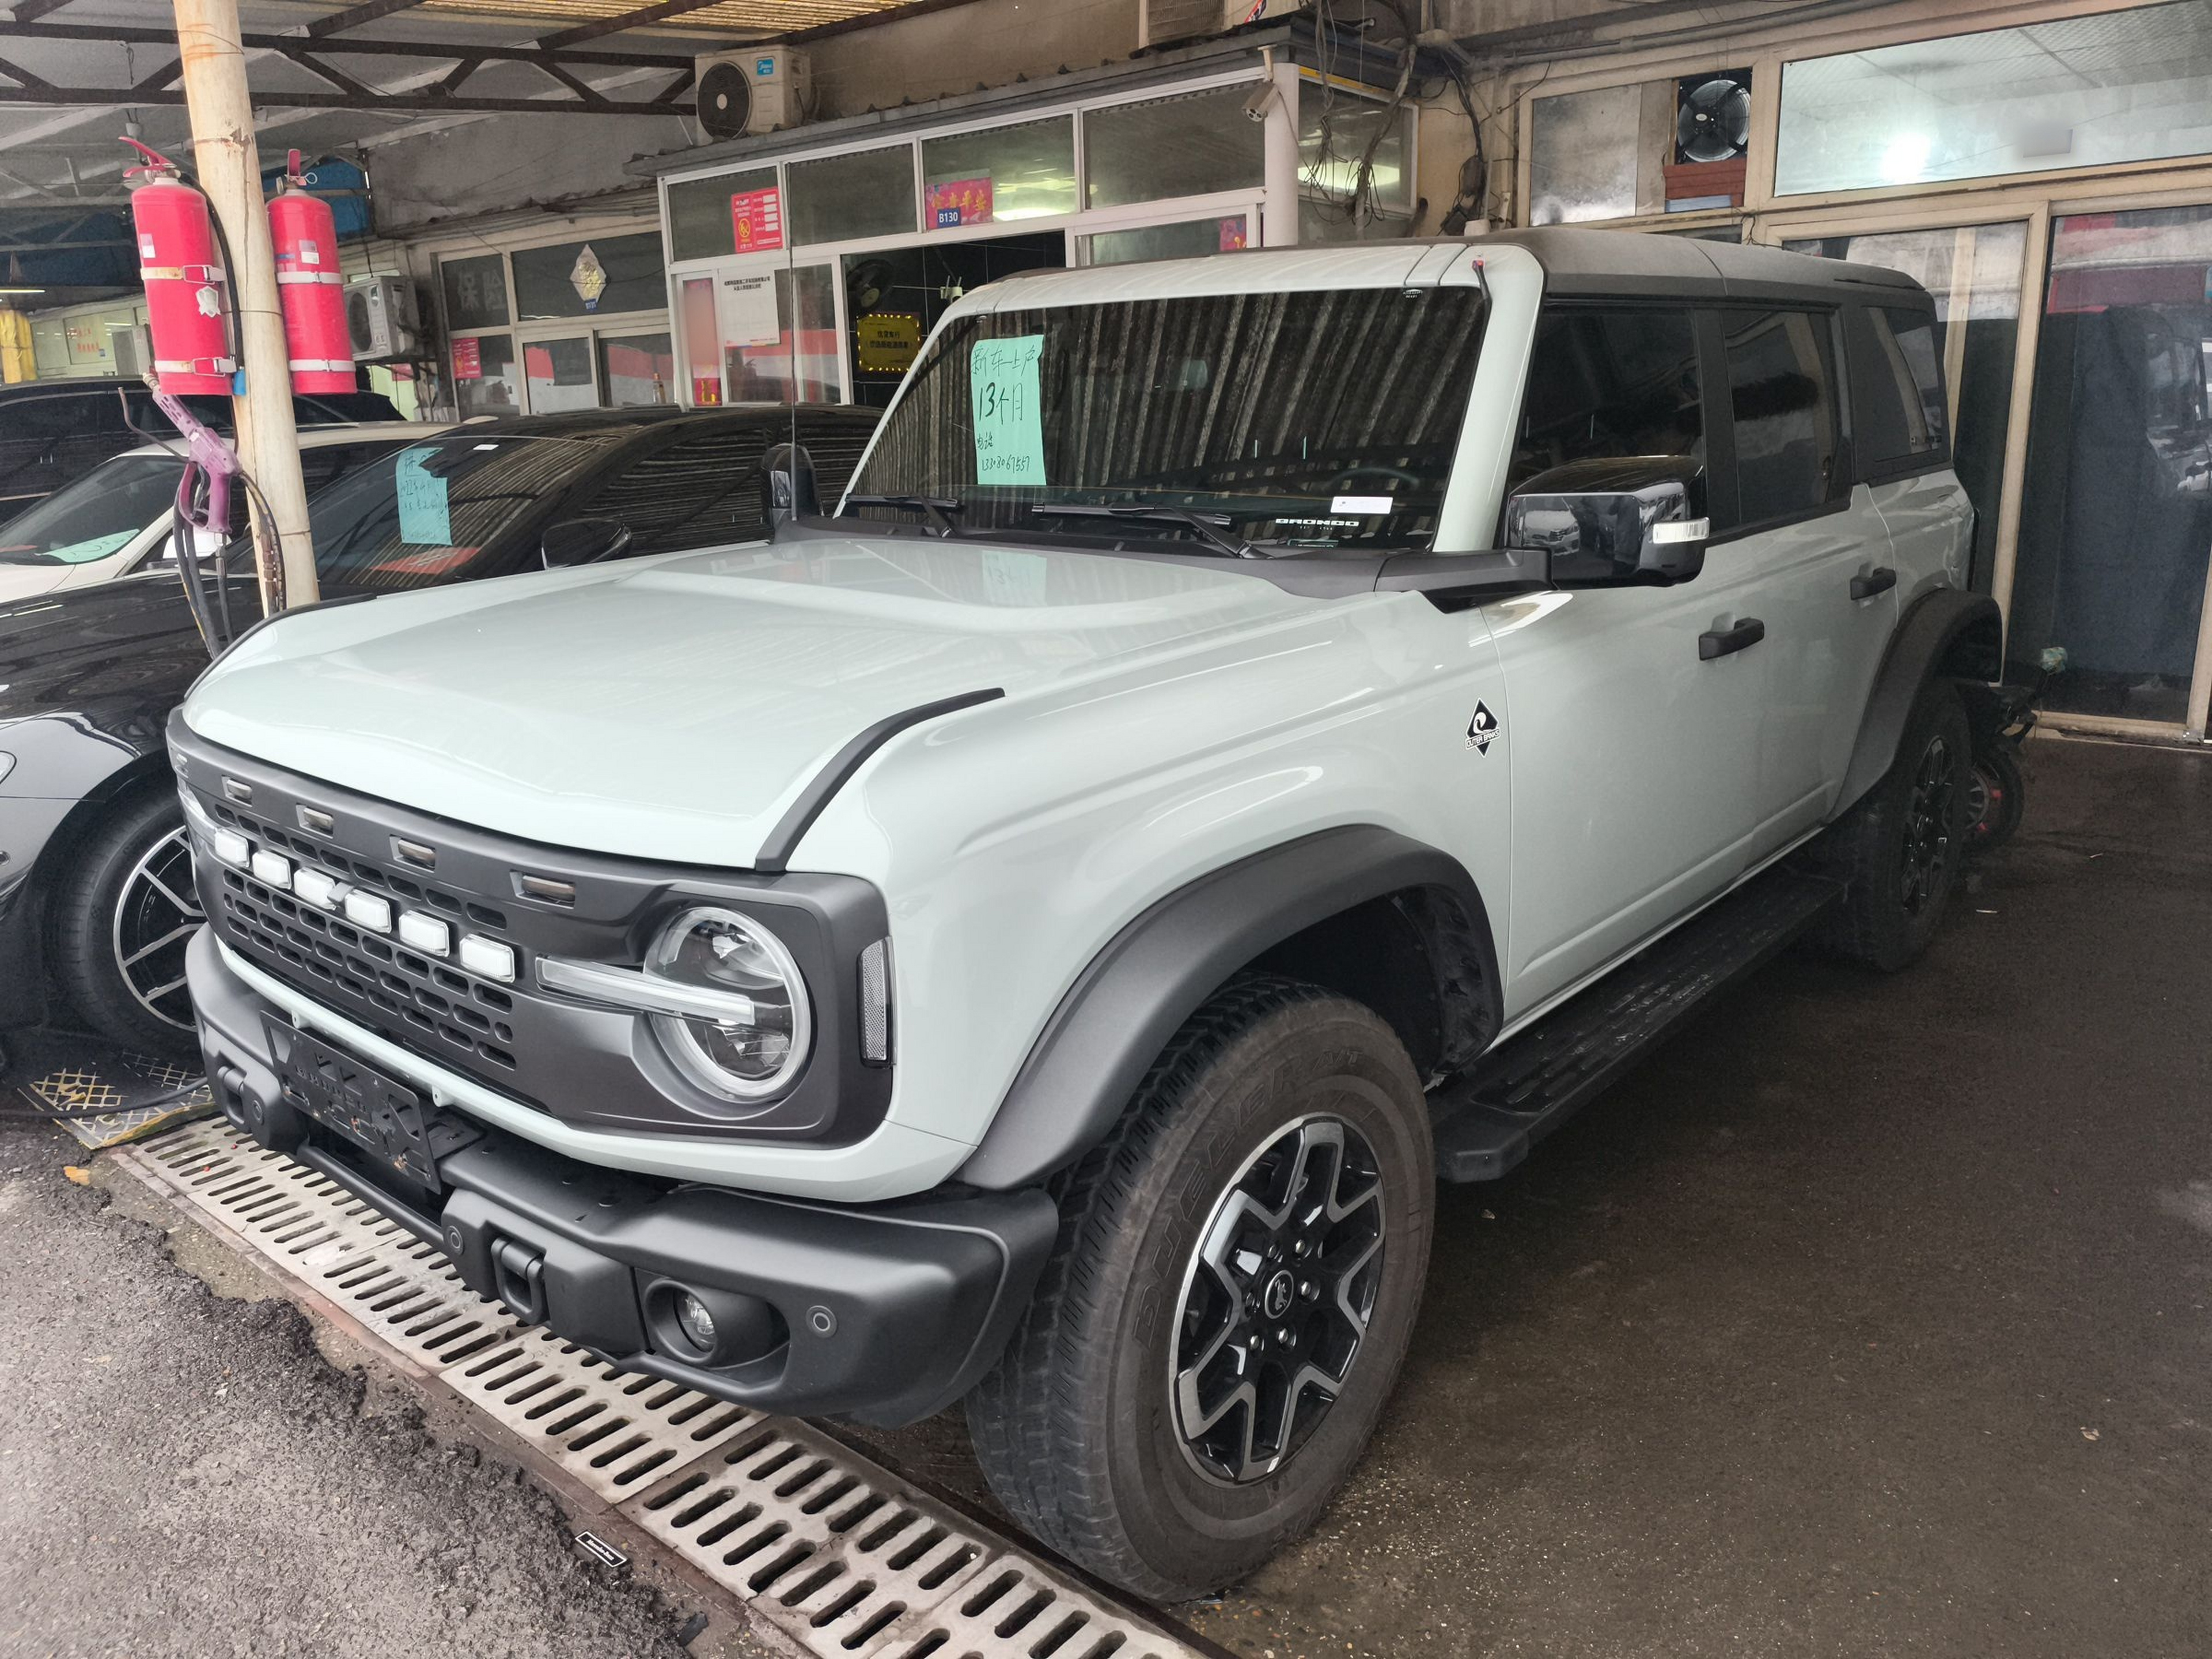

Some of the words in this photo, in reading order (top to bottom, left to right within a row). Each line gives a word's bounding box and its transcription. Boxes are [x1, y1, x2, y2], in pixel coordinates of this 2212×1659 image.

[938, 211, 959, 223] B130
[979, 382, 1022, 425] 13个月
[977, 432, 993, 450] 电话
[1467, 735, 1483, 747] OUTER
[1483, 729, 1500, 741] BANKS
